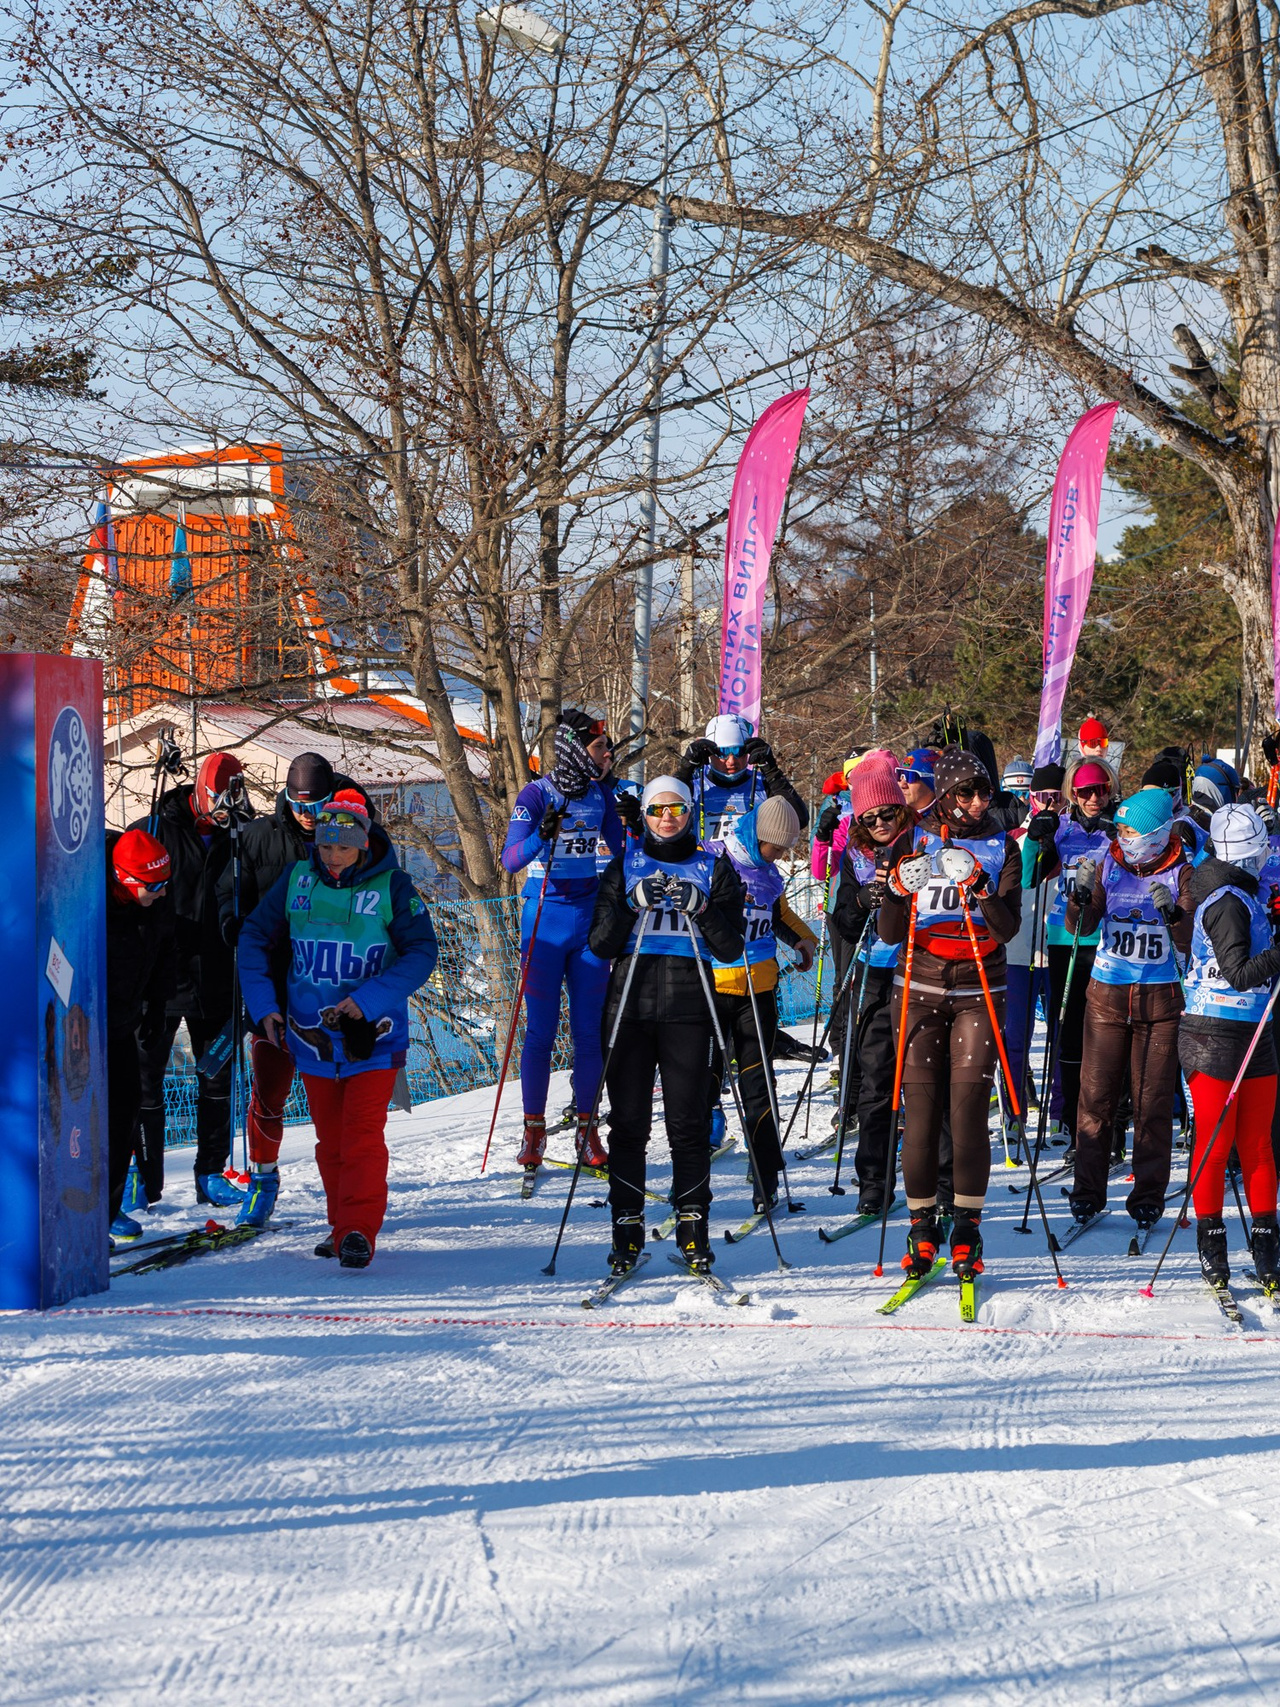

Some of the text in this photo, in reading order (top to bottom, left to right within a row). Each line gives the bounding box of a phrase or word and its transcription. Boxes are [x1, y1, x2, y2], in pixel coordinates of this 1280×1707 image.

[727, 623, 759, 714] ПОРТА
[355, 890, 381, 916] 12
[651, 907, 690, 931] 71
[1112, 930, 1162, 960] 1015
[290, 937, 387, 987] СУДЬЯ
[1251, 1227, 1272, 1235] TISA
